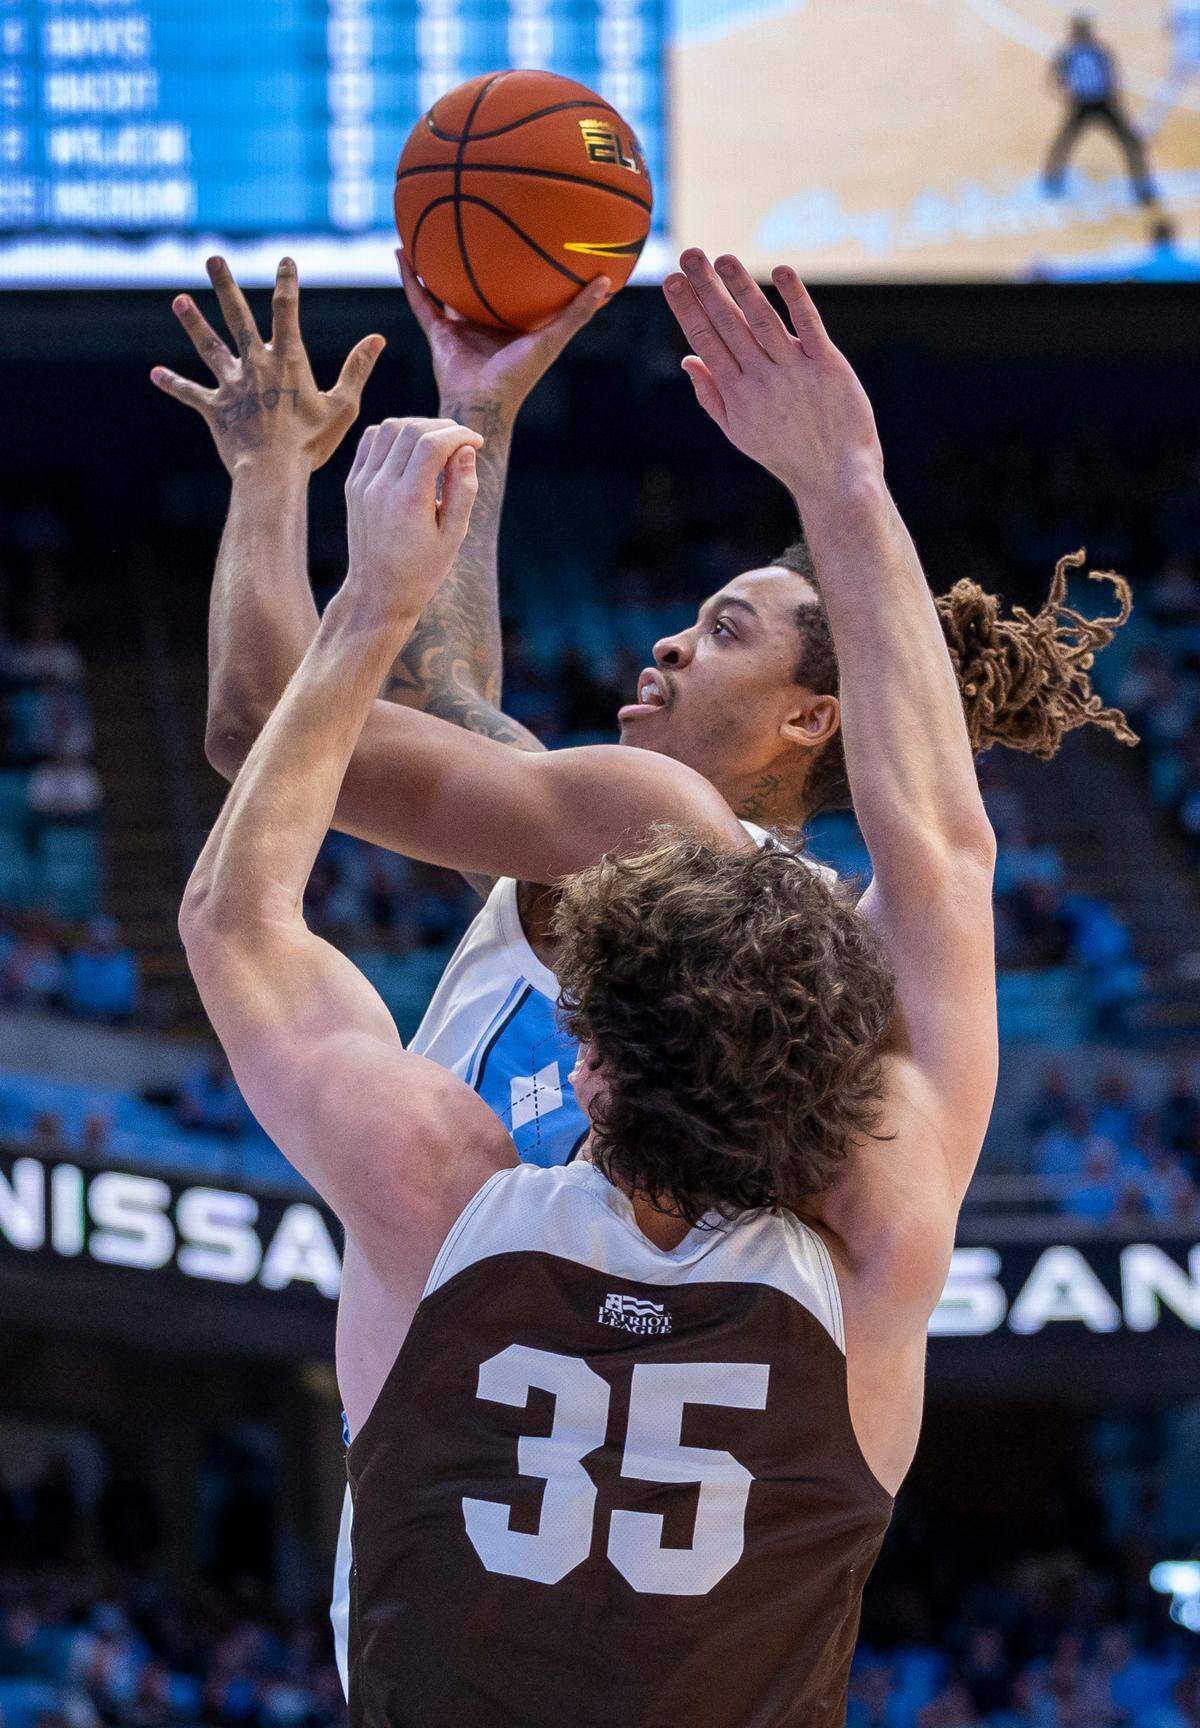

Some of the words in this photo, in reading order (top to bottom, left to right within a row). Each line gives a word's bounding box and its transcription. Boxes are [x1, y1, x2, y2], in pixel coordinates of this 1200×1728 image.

[598, 1315, 672, 1335] LEAGUE
[599, 1306, 672, 1327] PATRIOT
[462, 1344, 770, 1595] 35
